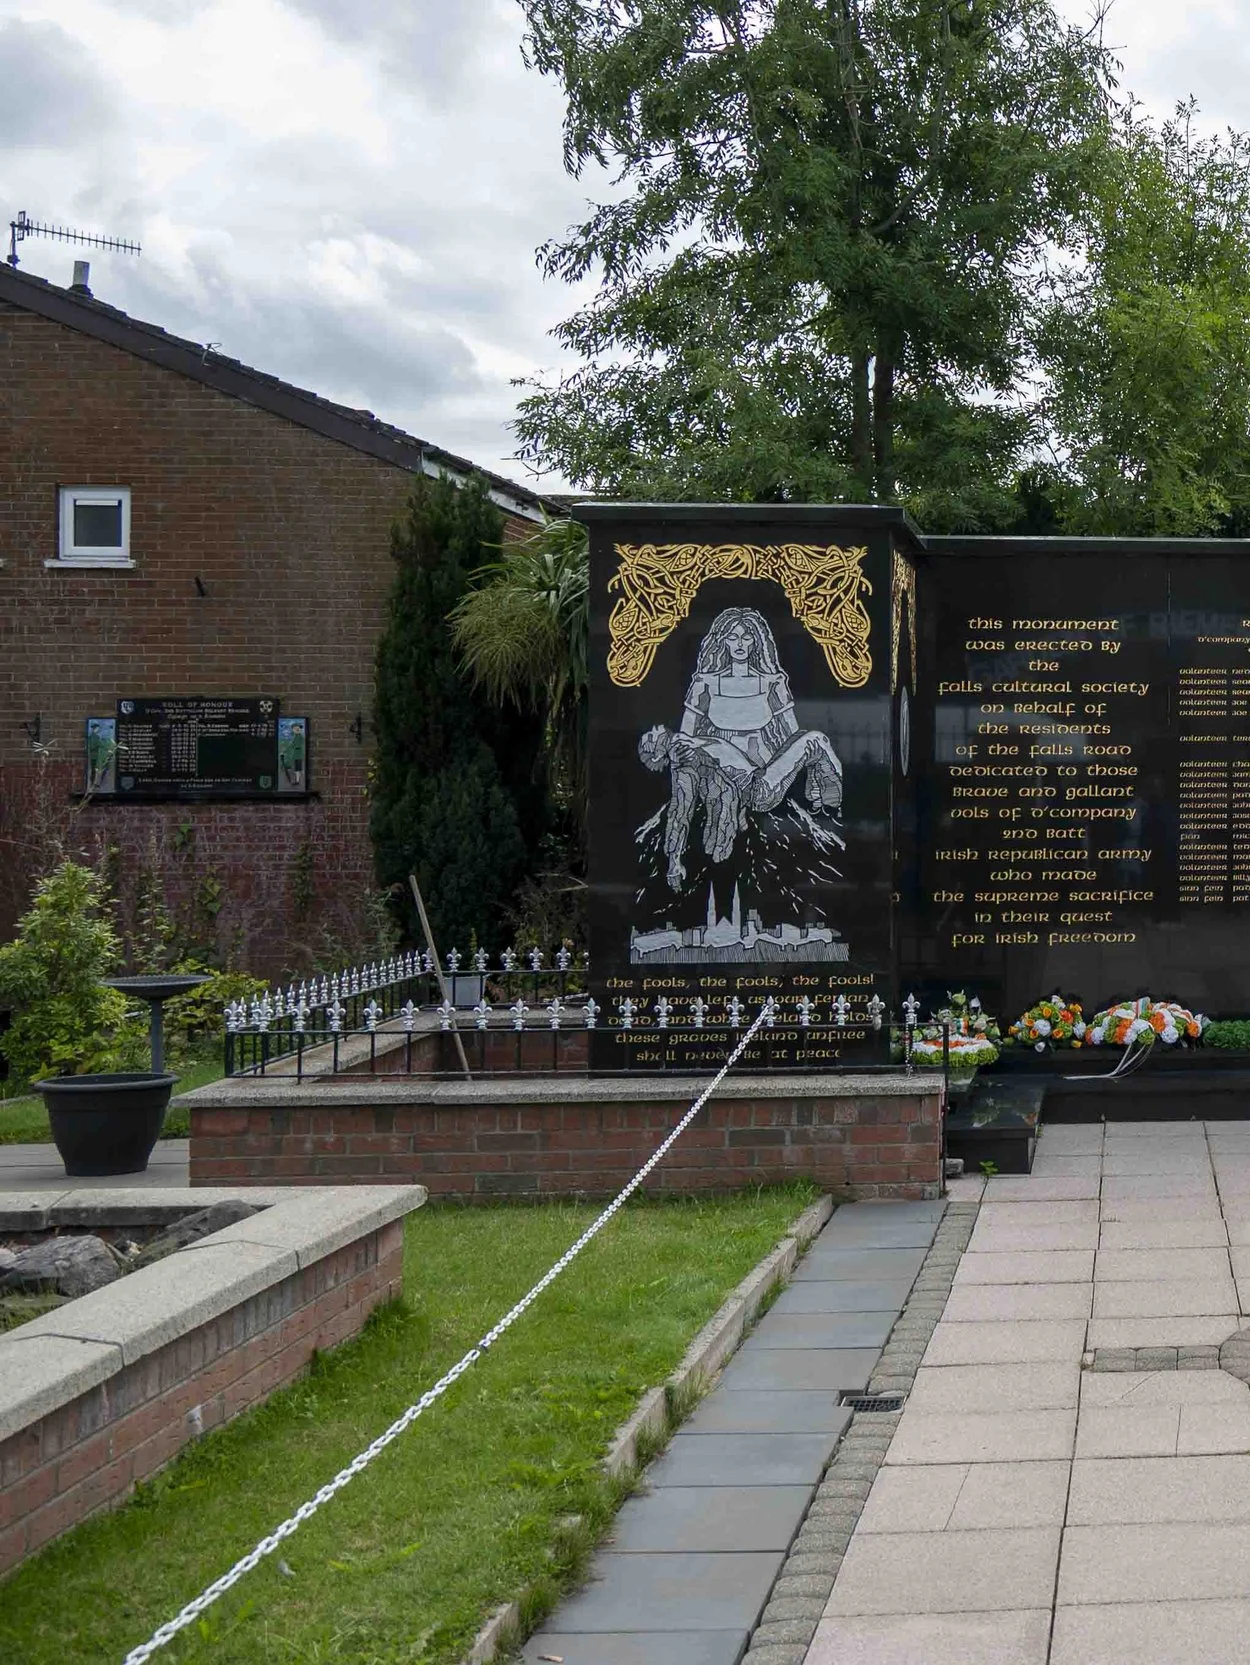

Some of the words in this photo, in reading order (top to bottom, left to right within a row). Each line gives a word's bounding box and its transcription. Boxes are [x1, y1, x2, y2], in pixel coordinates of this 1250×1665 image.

[707, 994, 737, 1007] lef
[813, 994, 869, 1007] feian
[705, 1013, 751, 1025] whe
[764, 1012, 822, 1023] elad
